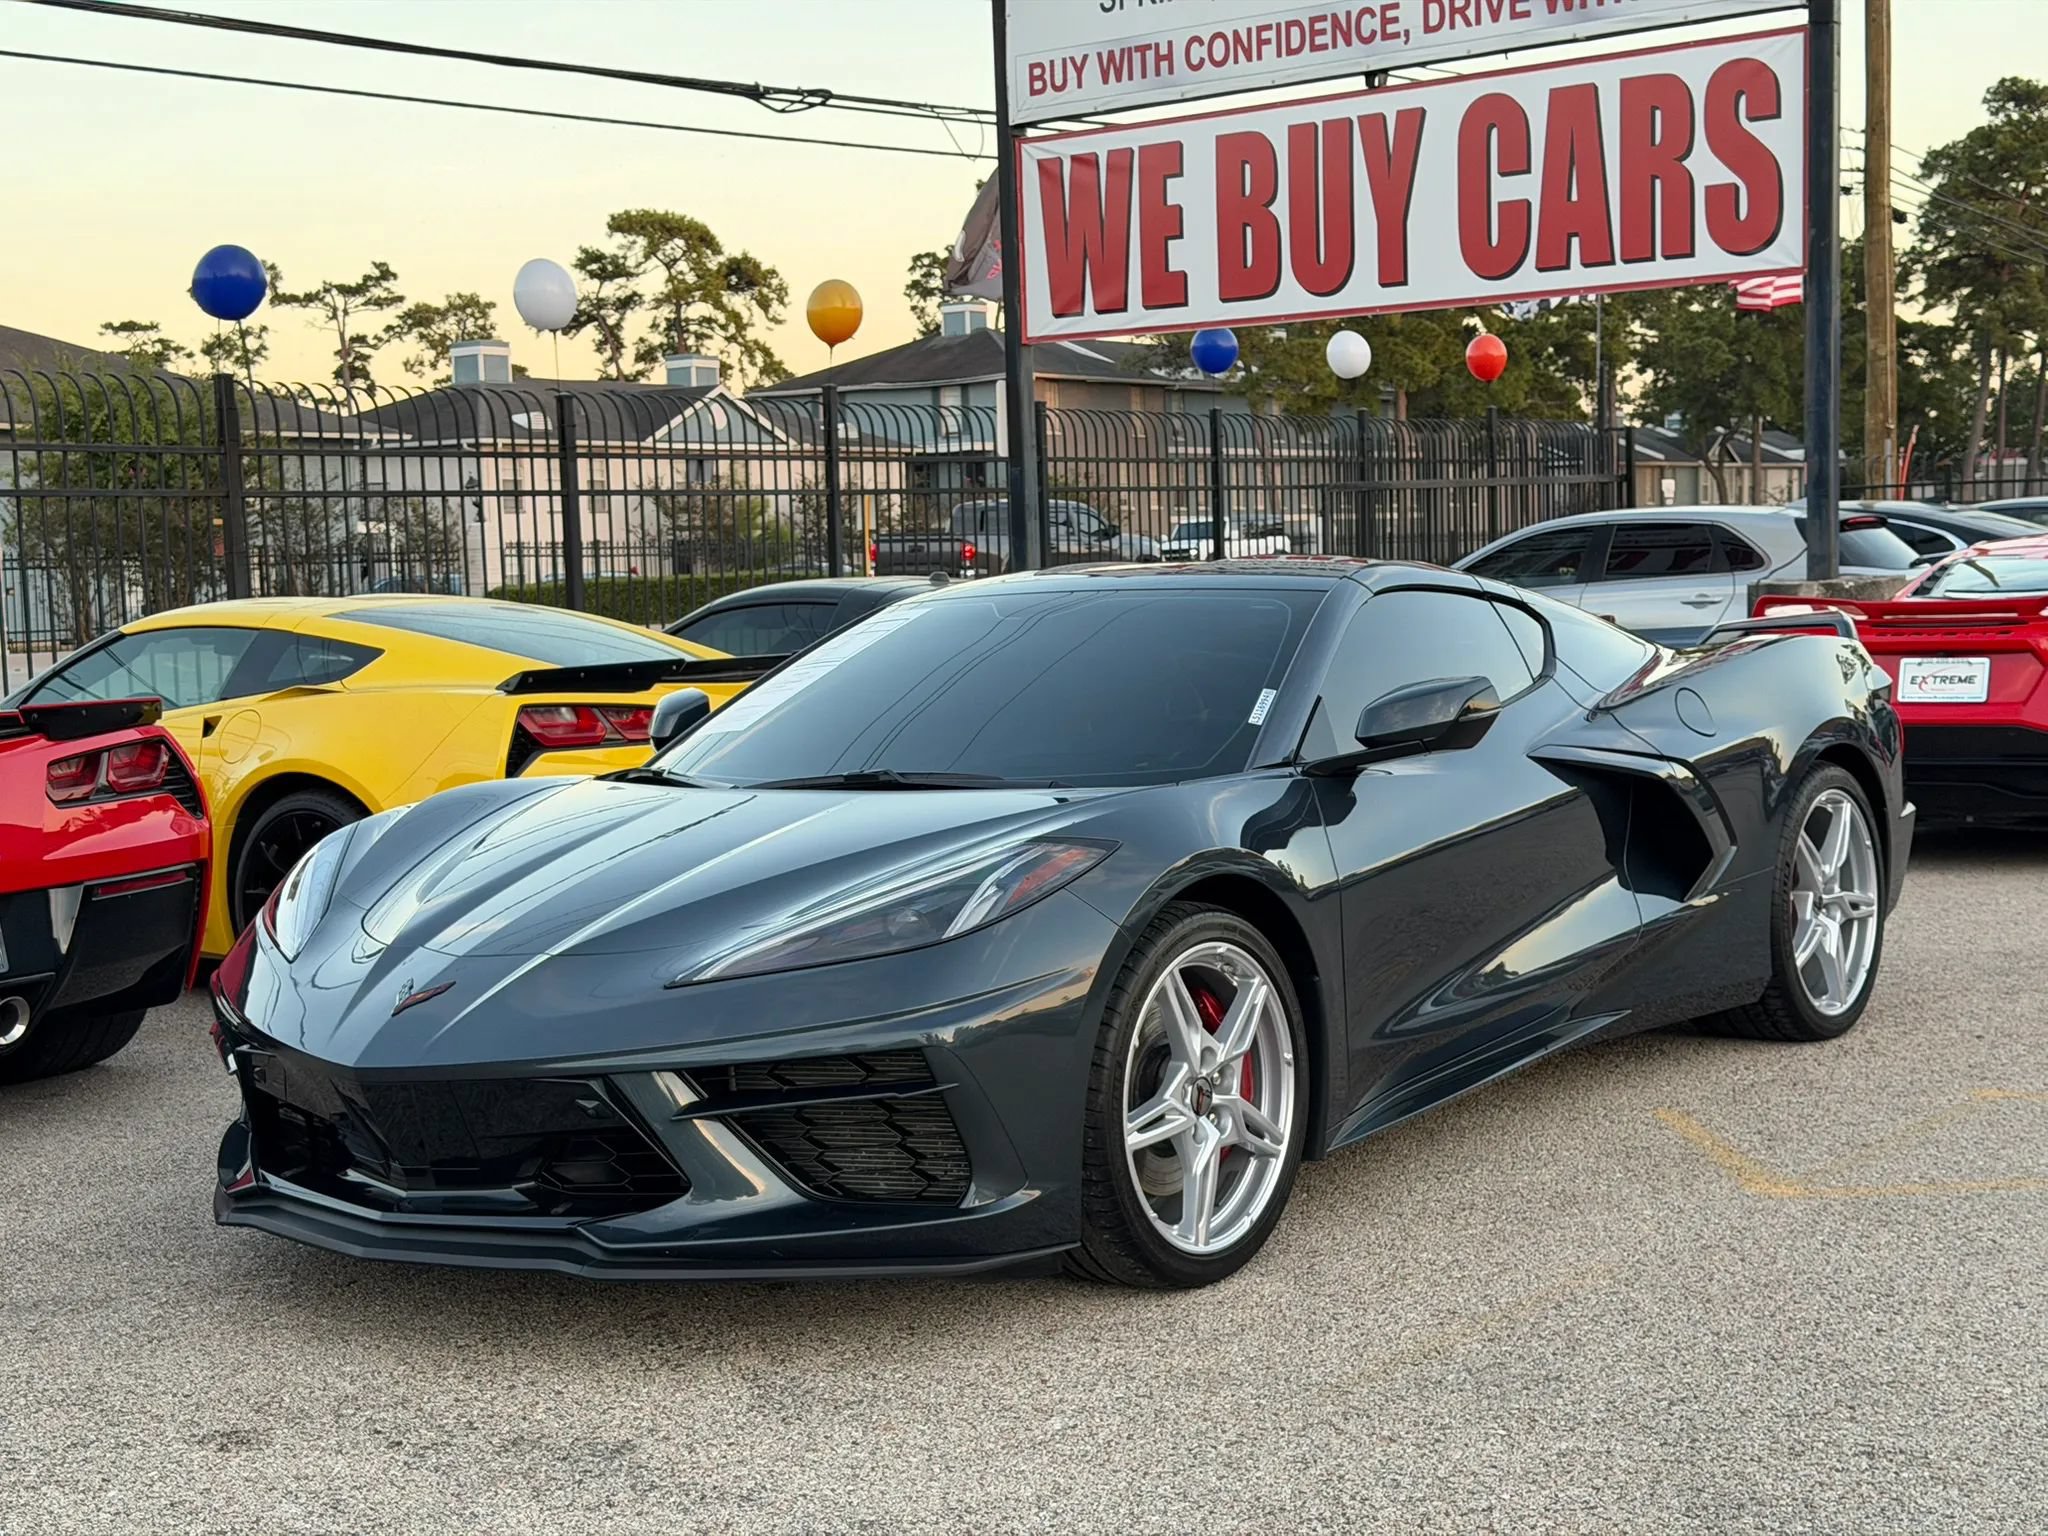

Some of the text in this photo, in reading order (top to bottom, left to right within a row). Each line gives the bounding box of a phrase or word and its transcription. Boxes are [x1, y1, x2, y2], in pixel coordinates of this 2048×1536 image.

[1028, 0, 1532, 97] BUY WITH CONFIDENCE, DRIVE
[1037, 57, 1784, 318] WE BUY CARS
[1910, 675, 1978, 685] EXTREME
